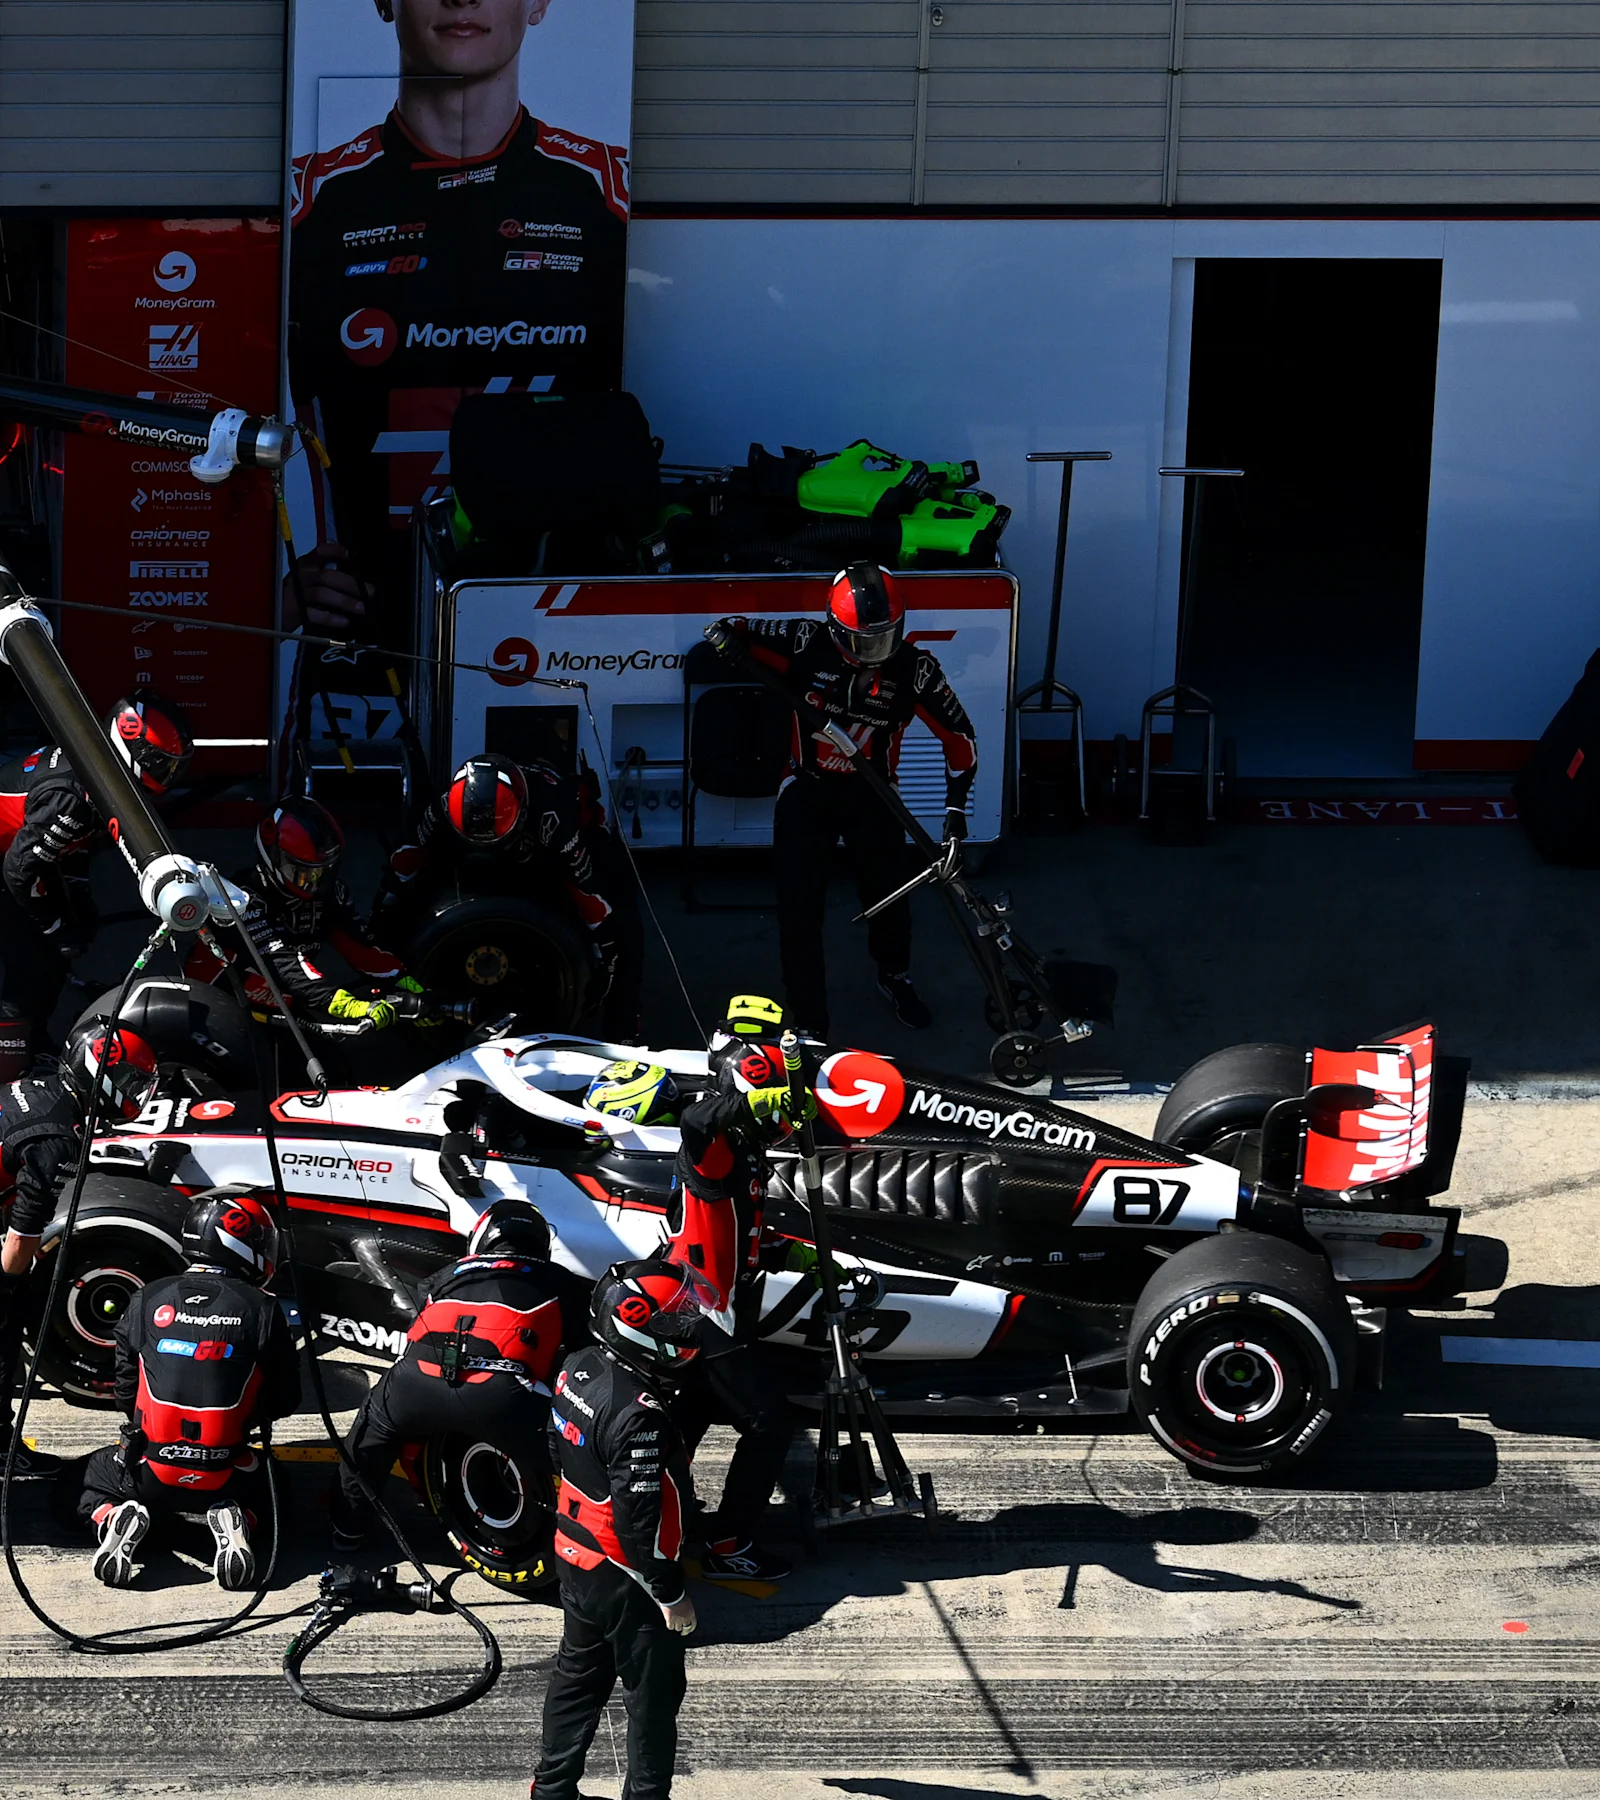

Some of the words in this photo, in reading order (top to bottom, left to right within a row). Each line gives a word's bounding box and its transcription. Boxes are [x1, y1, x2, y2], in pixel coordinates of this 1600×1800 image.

[525, 221, 582, 235] MoneyGram
[345, 231, 425, 248] INSURANCE
[387, 254, 420, 275] GO
[505, 257, 540, 270] GR
[544, 252, 584, 264] TOYOTA
[135, 297, 217, 311] MoneyGram
[405, 320, 587, 352] MoneyGram
[149, 354, 199, 366] HAAS
[119, 419, 208, 448] MoneyGram
[151, 489, 212, 504] Mphasis
[131, 540, 208, 548] INSURANCE
[129, 560, 211, 579] PIRELLI
[128, 591, 209, 607] ZOOMEX
[909, 1090, 1097, 1153] MoneyGram
[281, 1152, 393, 1174] ORION180
[283, 1167, 389, 1184] INSURANCE
[1113, 1175, 1191, 1226] 87
[175, 1311, 242, 1328] MoneyGram
[1144, 1295, 1210, 1361] ZERO
[1140, 1362, 1152, 1386] P
[1289, 1408, 1333, 1456] PIRELLI
[467, 1553, 529, 1585] ZERO
[531, 1557, 546, 1580] P
